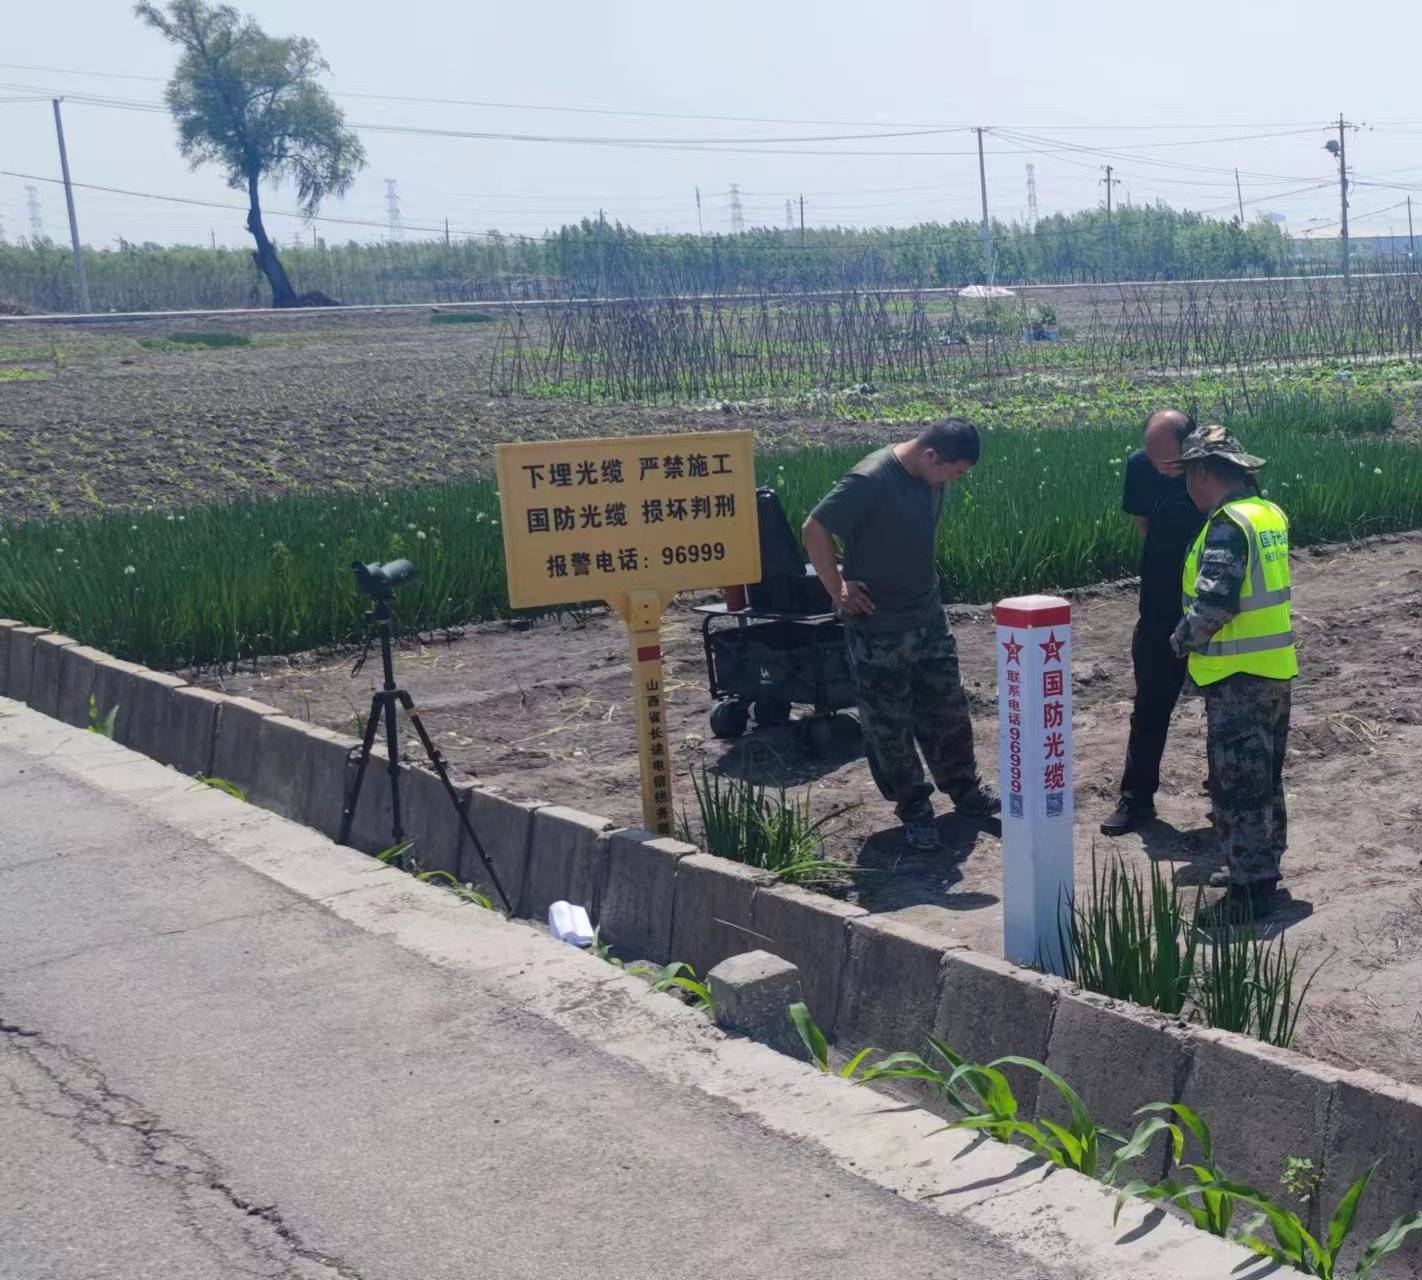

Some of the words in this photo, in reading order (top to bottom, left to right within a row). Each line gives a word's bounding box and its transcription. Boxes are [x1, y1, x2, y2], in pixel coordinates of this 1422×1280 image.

[521, 458, 625, 489] 下埋光缆
[639, 454, 733, 481] 严禁施工
[527, 502, 628, 534] 国防光缆
[642, 494, 735, 524] 损坏判刑
[1042, 669, 1066, 791] 国防光缆
